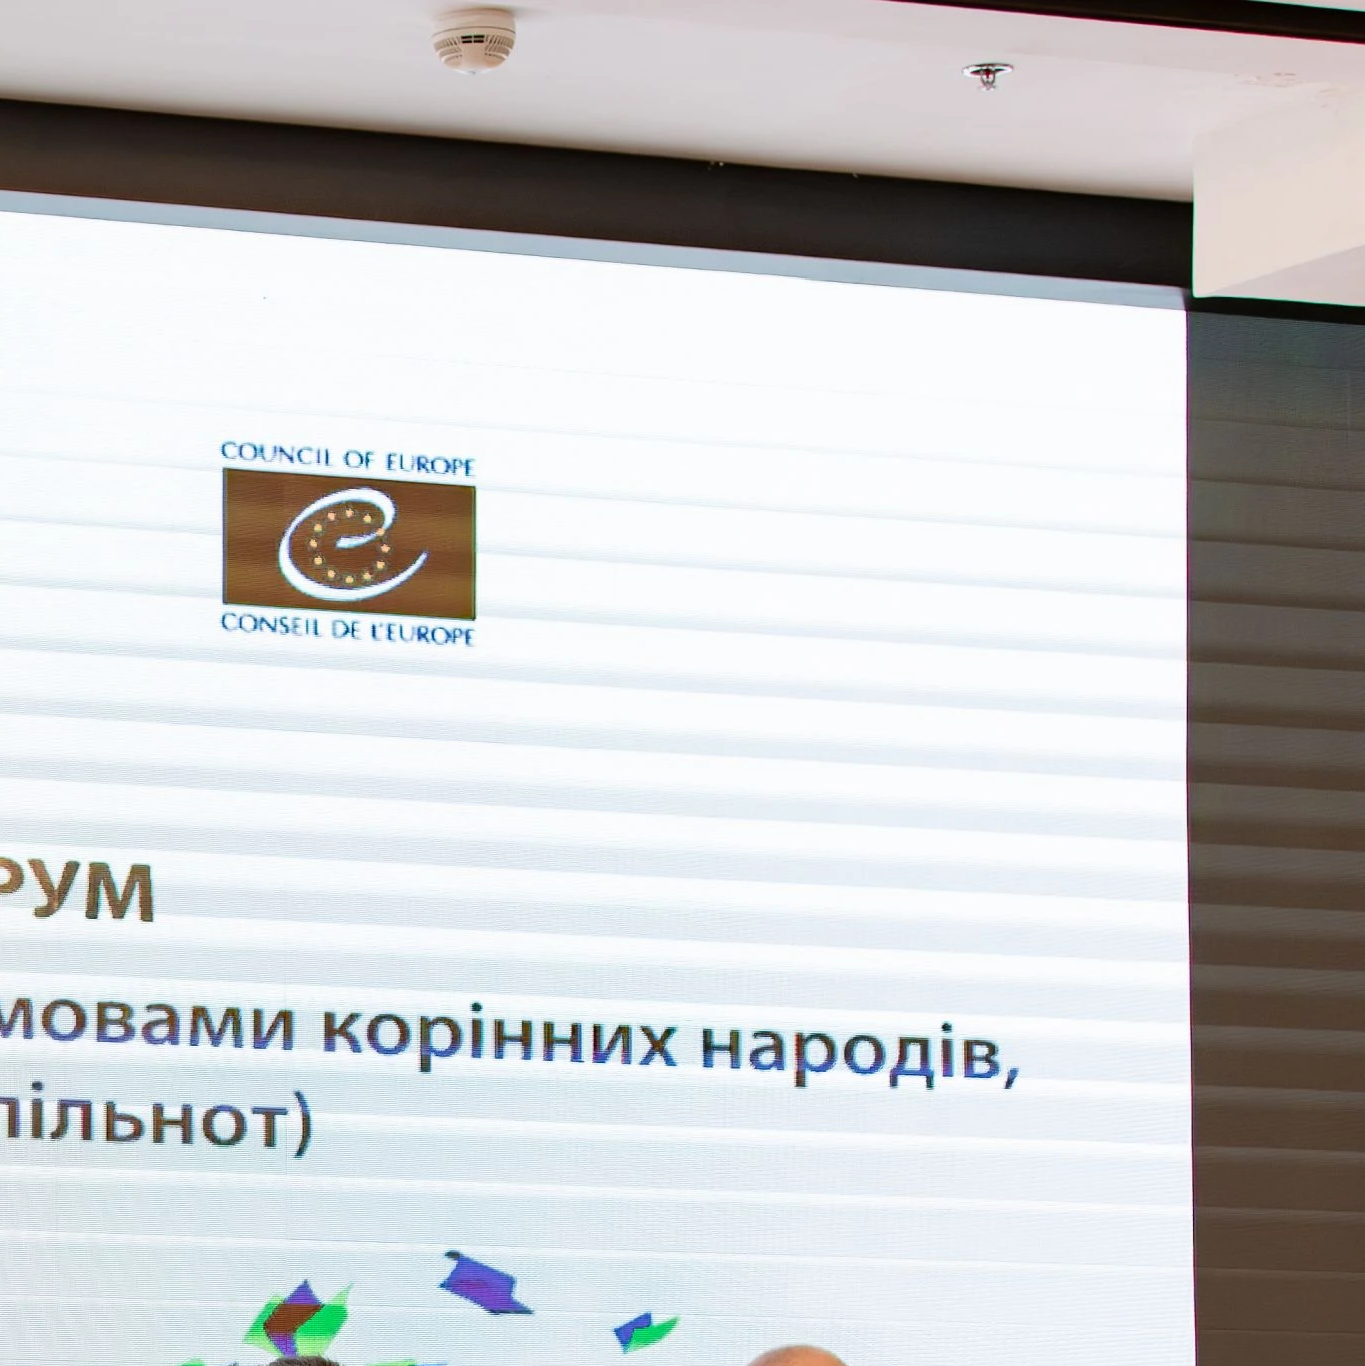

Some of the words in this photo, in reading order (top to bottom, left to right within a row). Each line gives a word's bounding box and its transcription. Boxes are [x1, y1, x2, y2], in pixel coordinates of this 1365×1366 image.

[220, 441, 334, 467] COUNCIL
[344, 450, 375, 469] OF
[387, 453, 476, 477] EUROPE
[220, 612, 322, 638] CONSEIL
[332, 619, 361, 640] DE
[371, 622, 476, 647] L'EUROPE
[322, 1001, 678, 1073] корінних
[701, 1022, 1019, 1090] народів,
